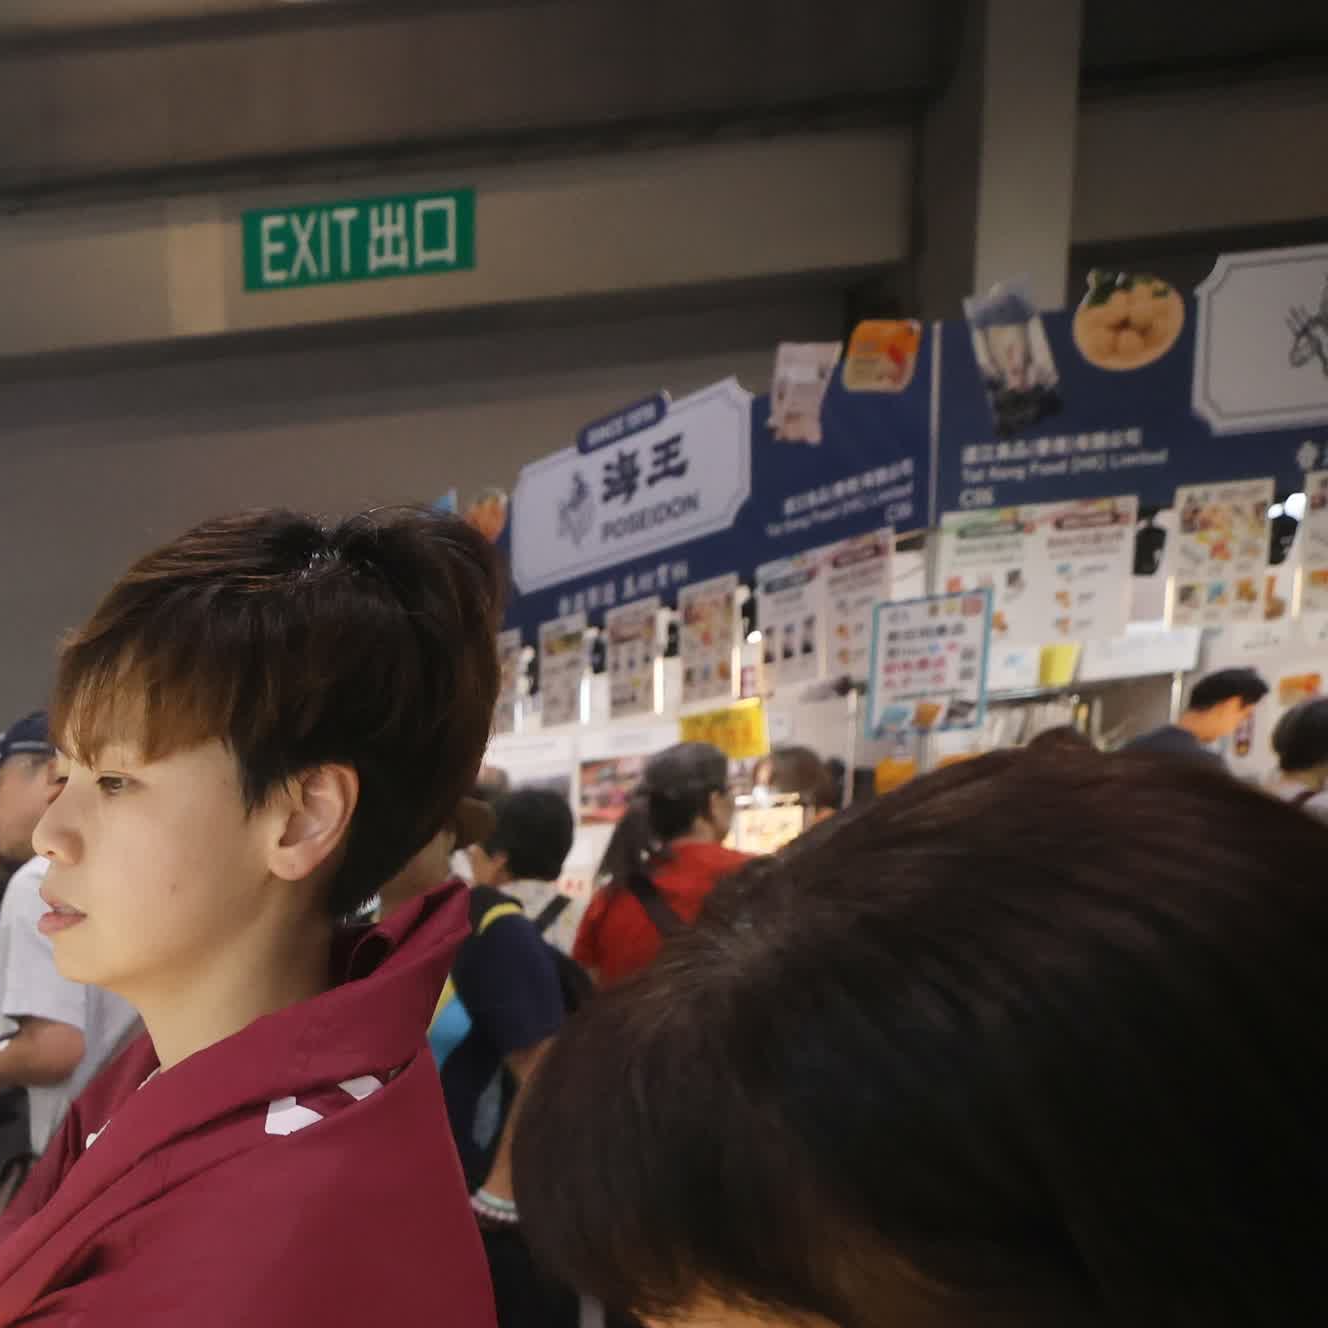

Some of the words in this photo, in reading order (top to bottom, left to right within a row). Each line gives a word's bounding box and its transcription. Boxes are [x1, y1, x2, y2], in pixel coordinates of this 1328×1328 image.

[259, 206, 360, 284] EXIT
[366, 196, 457, 274] 出口
[600, 431, 690, 505] 海王
[600, 490, 700, 544] POSEIDON
